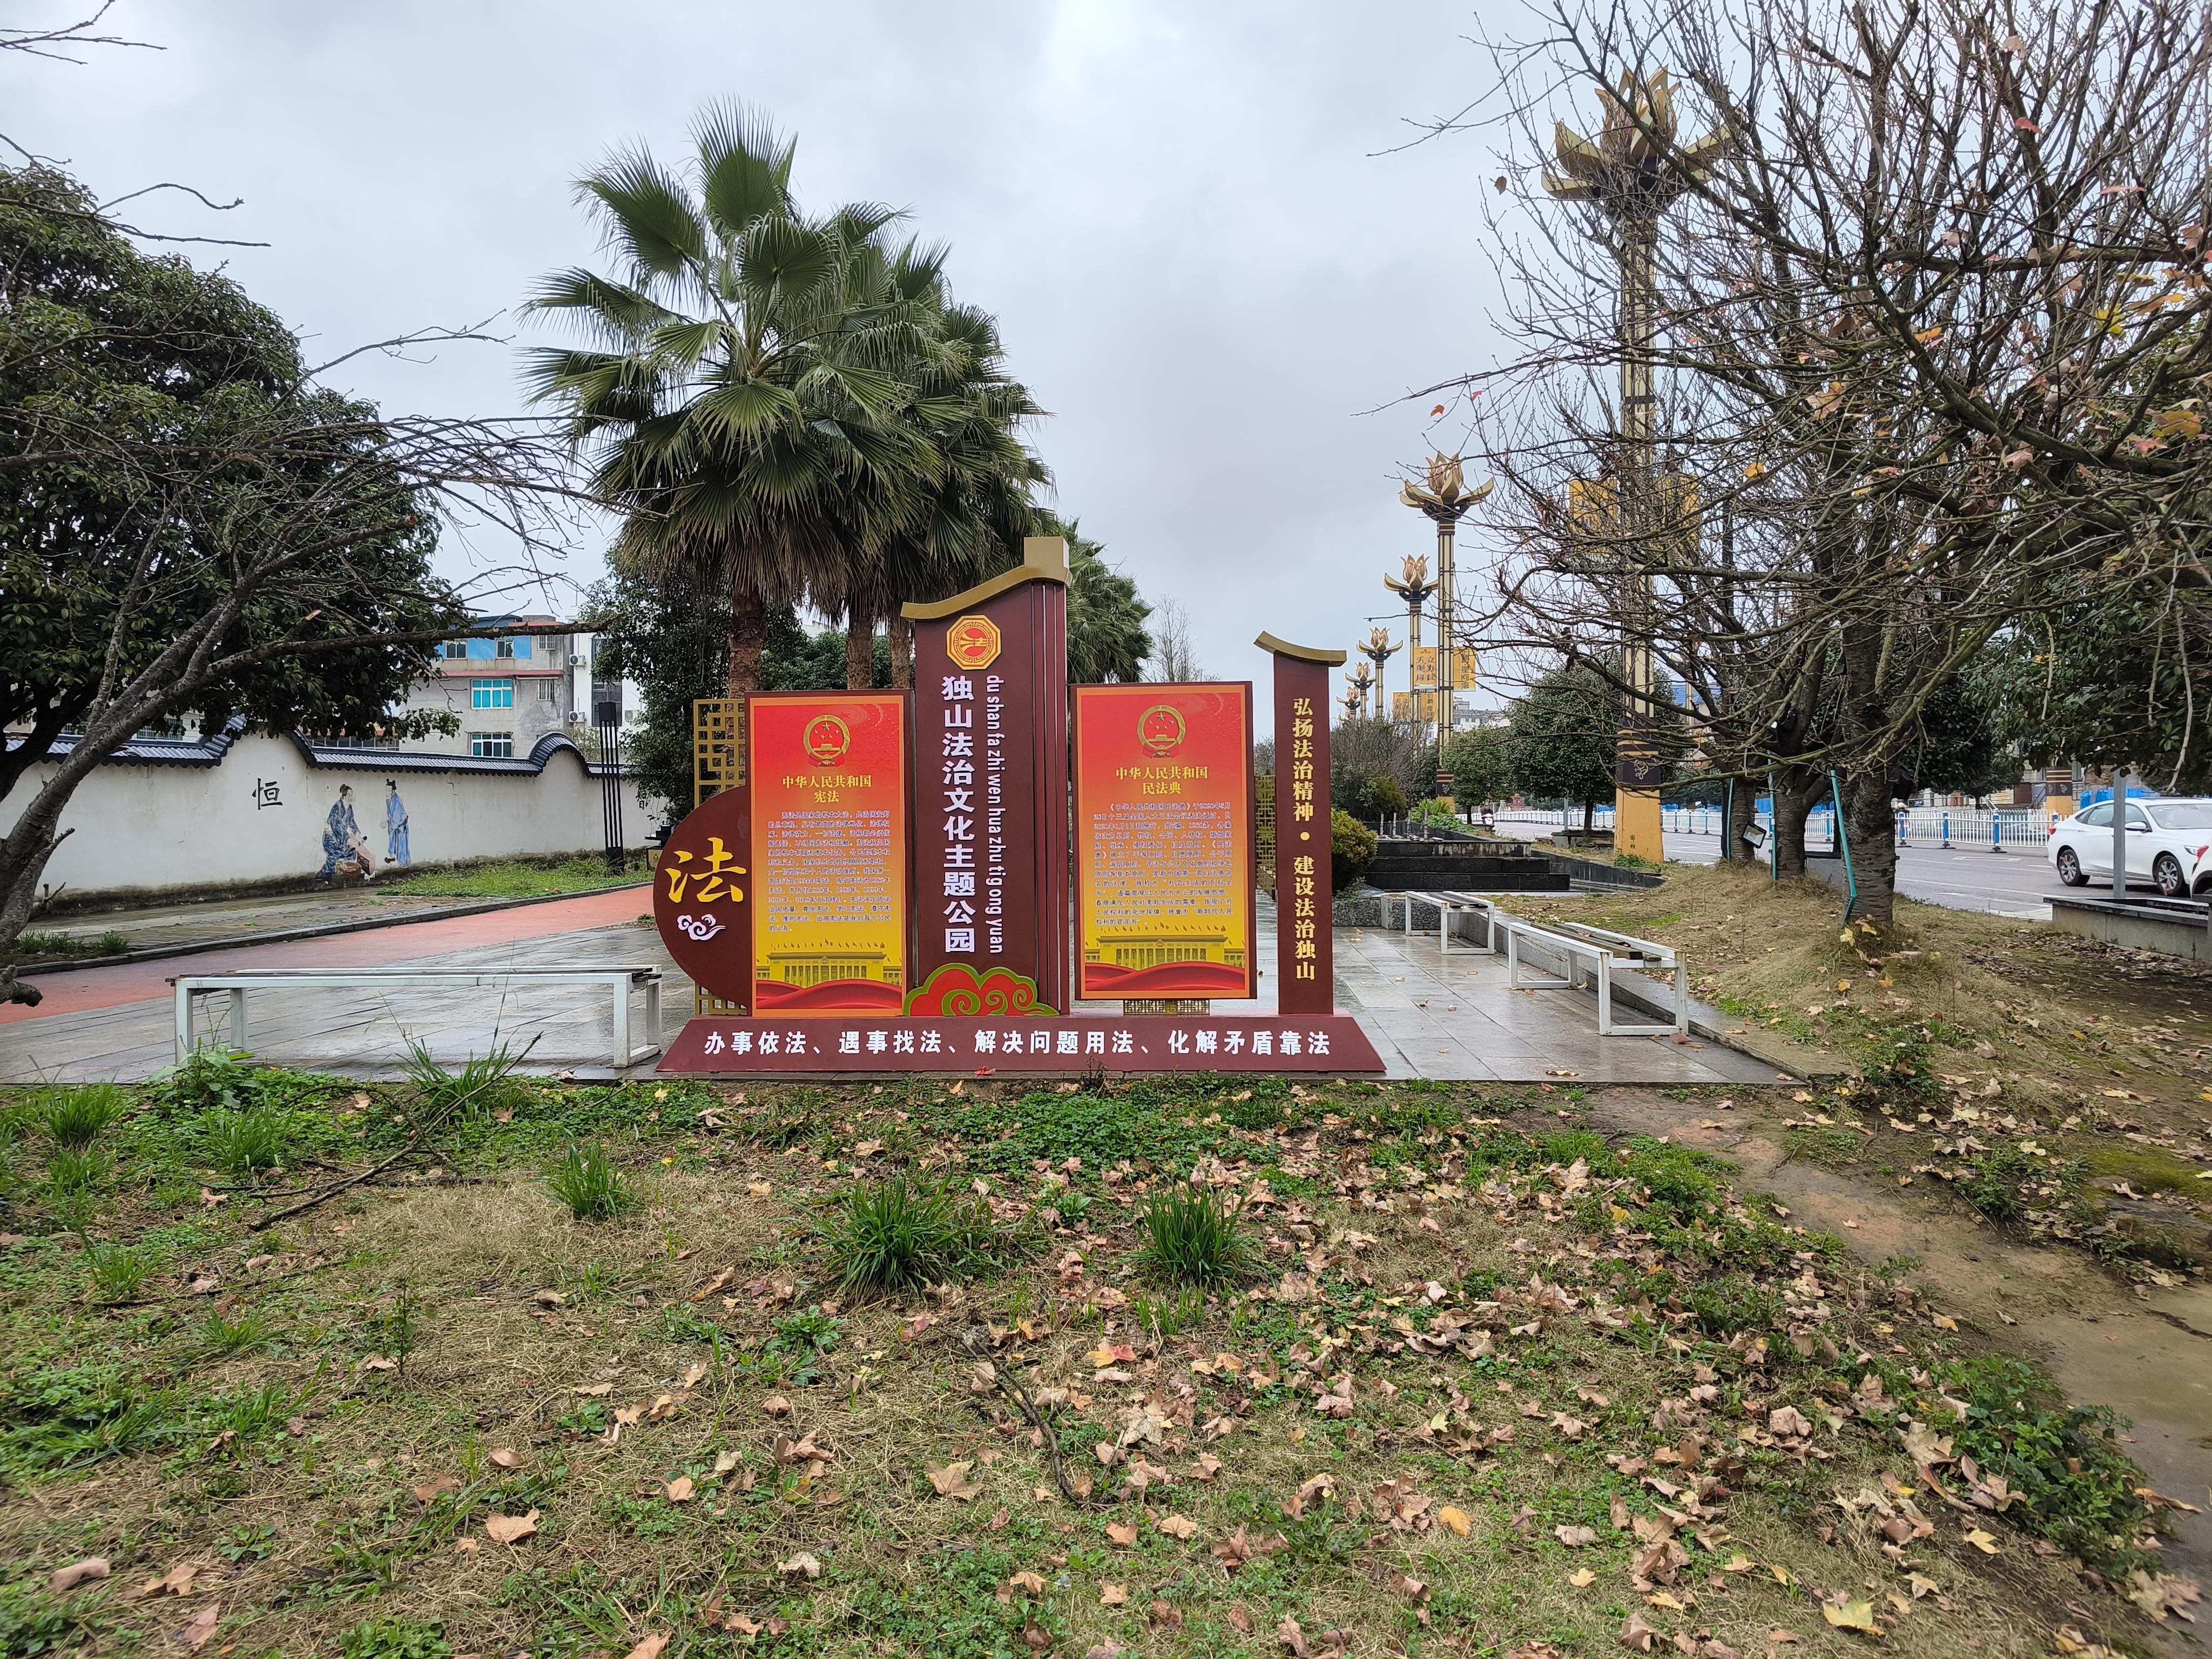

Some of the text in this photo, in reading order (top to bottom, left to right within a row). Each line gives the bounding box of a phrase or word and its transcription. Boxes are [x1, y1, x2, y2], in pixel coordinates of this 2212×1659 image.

[987, 676, 1004, 692] du
[987, 697, 1004, 730] shan
[987, 733, 1005, 746] fa
[987, 750, 1006, 771] zhi
[1116, 766, 1208, 780] 中华人民共和国
[252, 778, 283, 810] 恒
[783, 775, 872, 789] 中华人民共和国
[988, 774, 1001, 804] wen
[1143, 781, 1182, 795] 民法典
[814, 790, 840, 804] 宪法
[941, 676, 976, 953] 独山法治文化主题公园
[988, 808, 1006, 833] hua
[989, 837, 1007, 862] zhu
[665, 837, 746, 903] 法
[986, 918, 1003, 954] yuan
